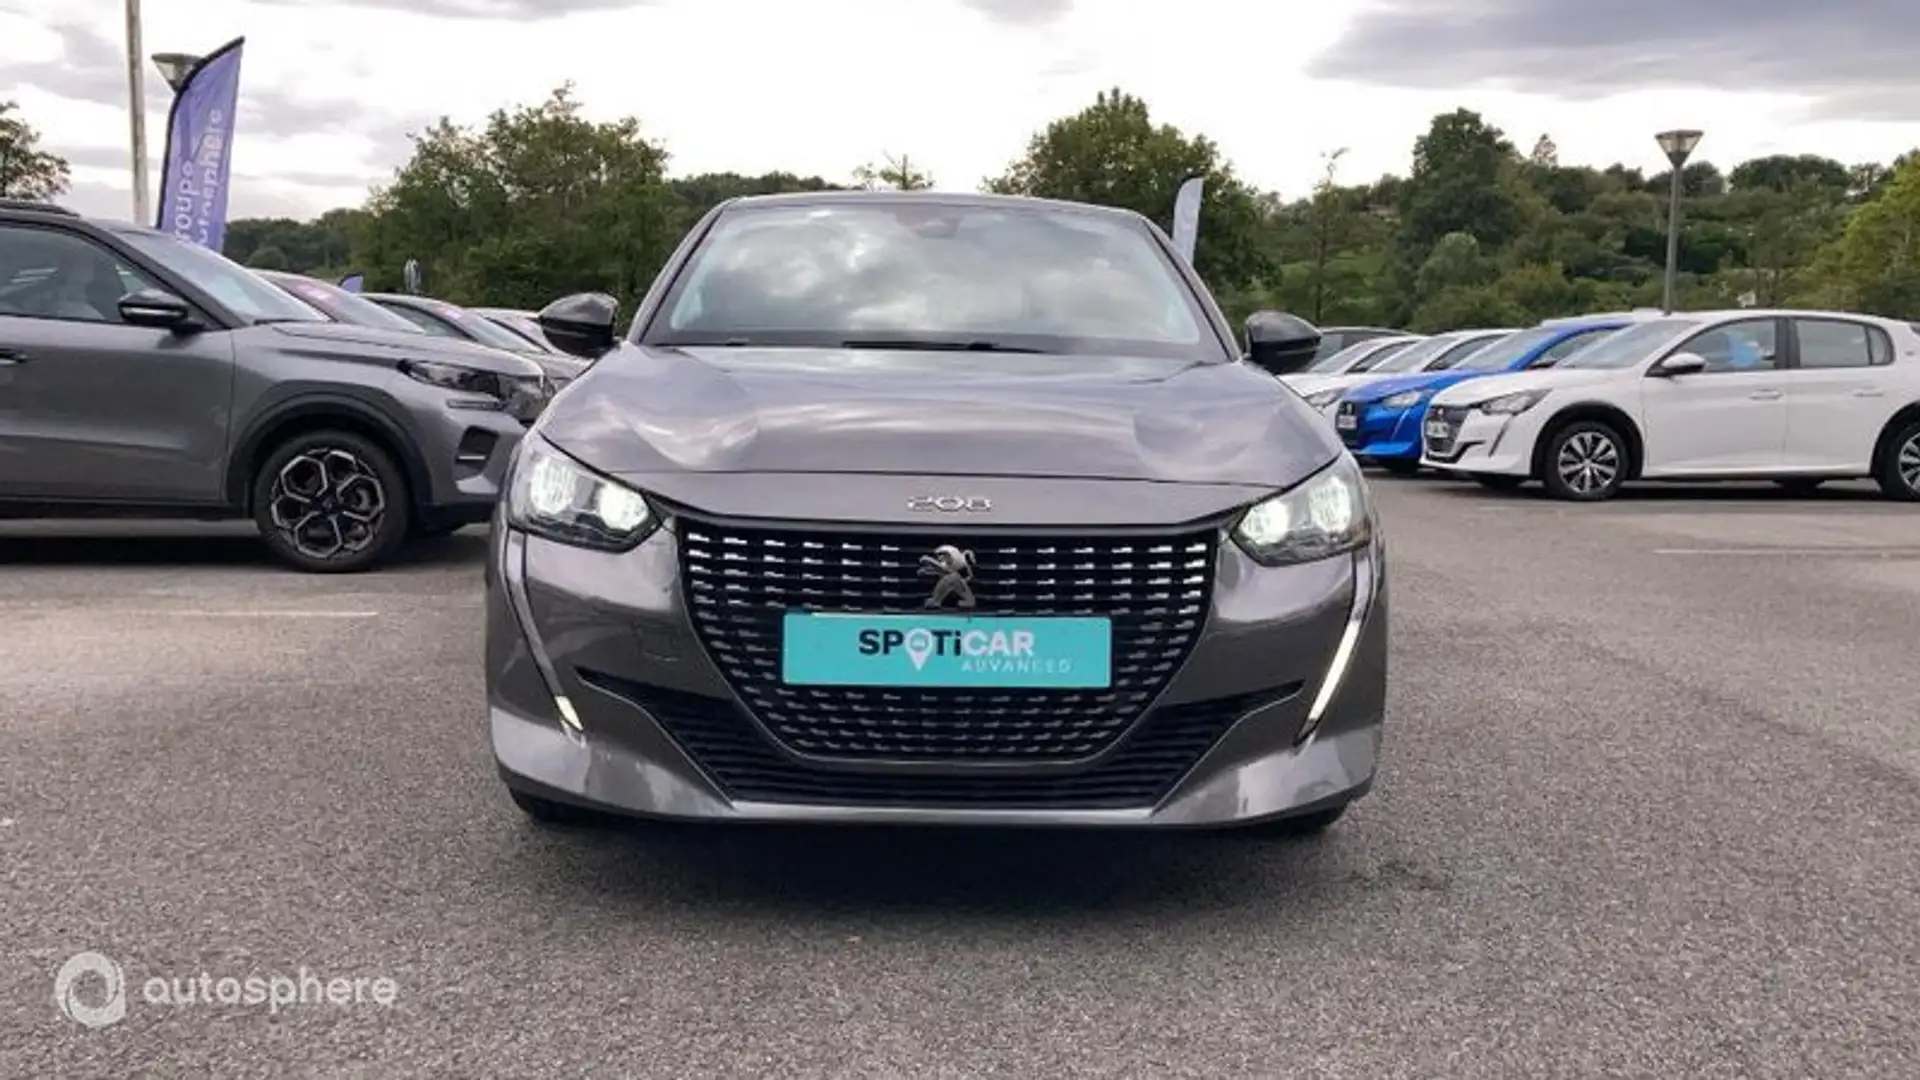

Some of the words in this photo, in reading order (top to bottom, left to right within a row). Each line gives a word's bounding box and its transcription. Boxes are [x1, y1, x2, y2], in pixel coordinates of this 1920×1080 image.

[175, 160, 200, 242] roupe
[197, 108, 223, 244] utosphere
[906, 494, 992, 512] 208
[960, 658, 1072, 673] ADVANCED
